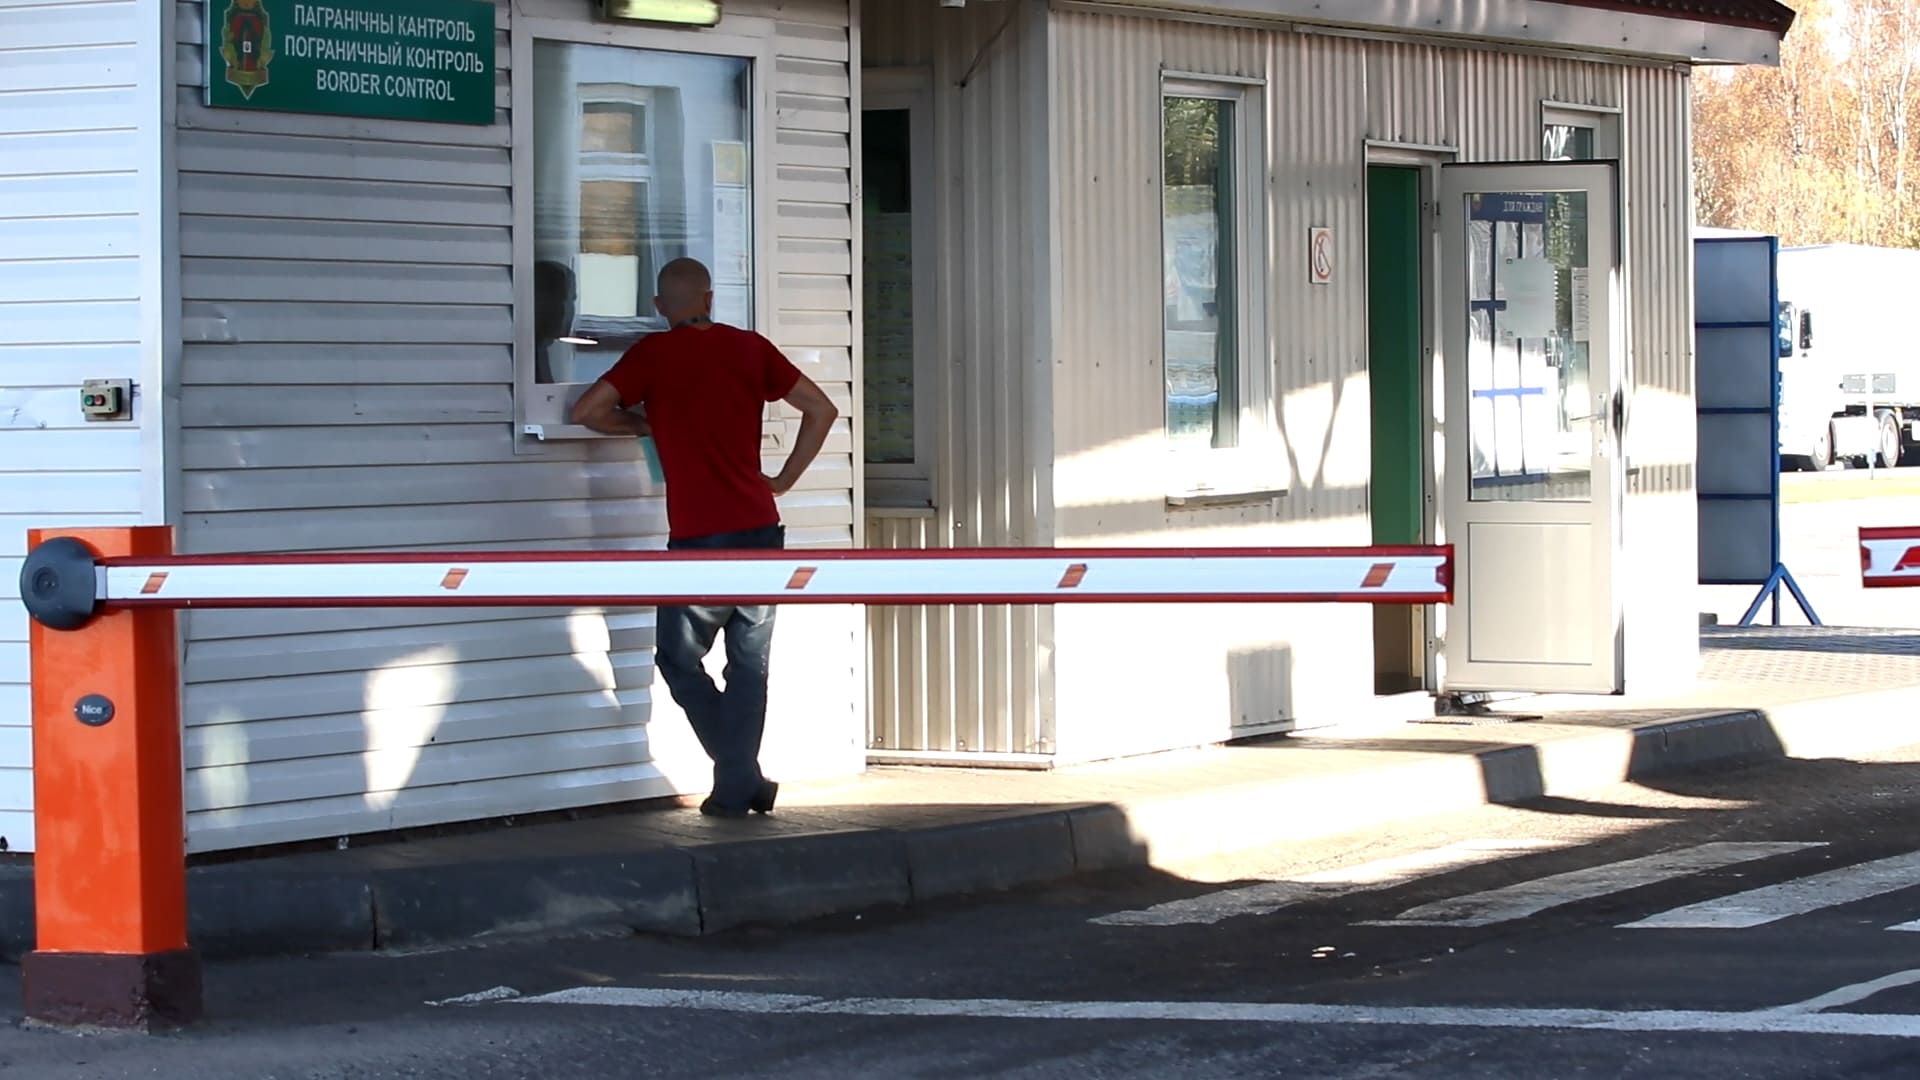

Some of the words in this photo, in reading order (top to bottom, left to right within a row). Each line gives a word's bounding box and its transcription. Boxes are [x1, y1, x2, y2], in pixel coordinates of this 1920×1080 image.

[294, 4, 393, 34] ПАГРАНІЧНЫ
[398, 15, 475, 42] КАНТРОЛЬ
[285, 35, 401, 65] ПОГРАНИЧНЫЙ
[405, 47, 484, 73] КОНТРОЛЬ
[316, 69, 380, 95] BORDER
[383, 75, 455, 101] CONTROL
[82, 704, 102, 714] Nice
